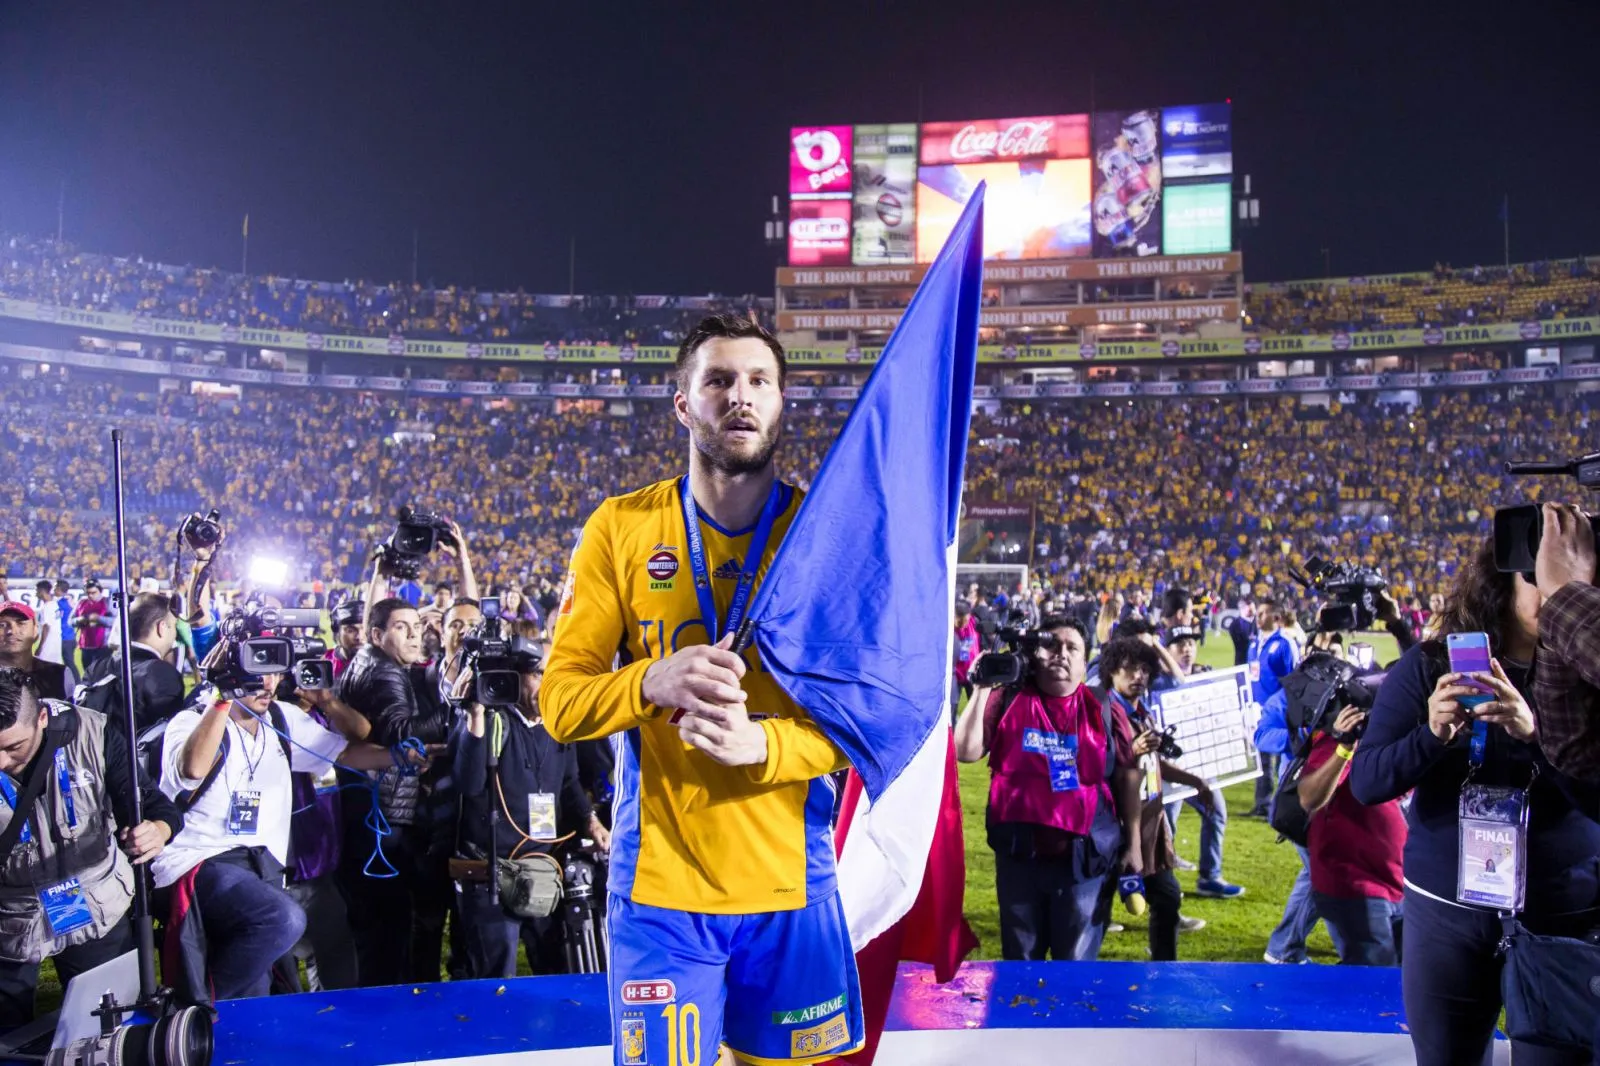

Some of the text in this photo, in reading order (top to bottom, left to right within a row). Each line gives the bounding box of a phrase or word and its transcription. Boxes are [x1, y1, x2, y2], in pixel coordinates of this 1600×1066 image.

[950, 121, 1054, 158] Coca-Cola
[1023, 265, 1070, 277] DEPOT
[1097, 258, 1227, 276] THE HOME DEPOT
[793, 270, 915, 284] THE HOME DEPOT
[1022, 311, 1071, 323] DEPOT
[1097, 305, 1227, 323] THE HOME DEPOT
[793, 315, 903, 328] THE HOME DEP
[154, 322, 196, 336] EXTRA
[1544, 321, 1592, 335] EXTRA
[243, 331, 281, 343] EXTRA
[1353, 334, 1395, 346] EXTRA
[1446, 329, 1490, 341] EXTRA
[326, 337, 364, 350] EXTRA
[407, 343, 442, 354] EXTRA
[1181, 342, 1220, 354] EXTRA
[1264, 339, 1303, 350] EXTRA
[485, 346, 520, 357] EXTRA
[561, 348, 596, 359] EXTRA
[637, 349, 671, 359] EXTRA
[788, 351, 822, 360] EXTRA
[1019, 348, 1052, 357] EXTRA
[1098, 345, 1135, 356] EXTRA
[240, 810, 252, 821] 72
[1475, 829, 1513, 844] FINAL
[48, 877, 79, 896] FINAL
[800, 995, 843, 1021] AFIRME
[660, 1002, 701, 1066] 10
